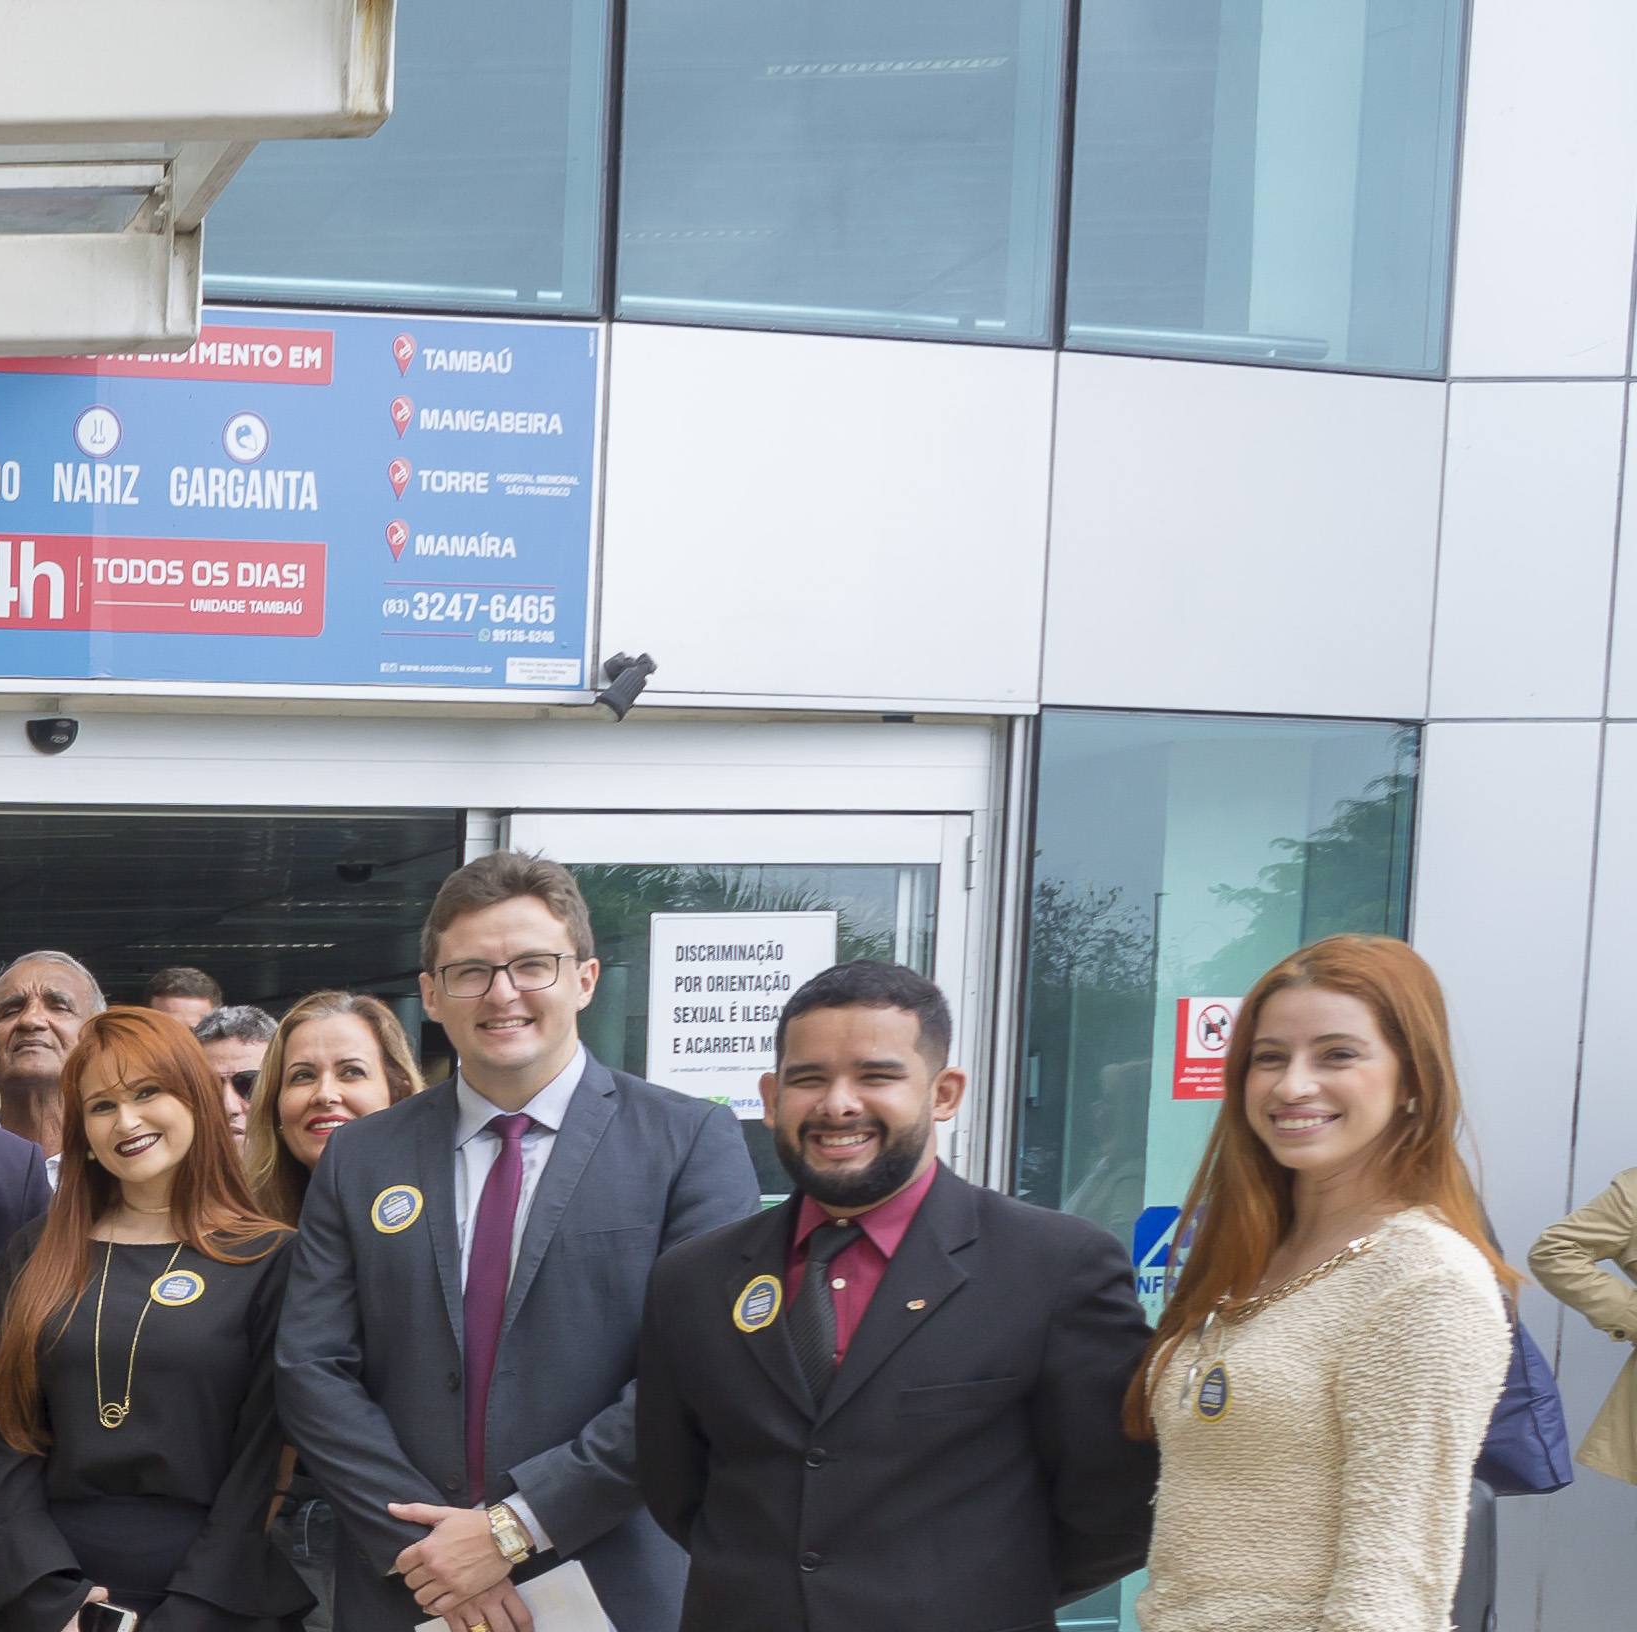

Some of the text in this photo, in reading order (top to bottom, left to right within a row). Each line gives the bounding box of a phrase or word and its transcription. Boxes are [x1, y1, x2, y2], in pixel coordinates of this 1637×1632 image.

[288, 345, 323, 370] EM
[422, 347, 512, 374] TAMBAÚ
[419, 408, 563, 435] MANGABEIRA
[53, 462, 140, 505] NARIZ
[170, 466, 319, 511] GARGANTA
[418, 470, 490, 494] TORRE
[415, 531, 517, 558] MANAÍRA
[93, 557, 305, 588] TODOS OS DIAS!
[190, 598, 302, 614] UNIDADE TAMBAÚ
[382, 591, 555, 624] (83) 3247-6465
[675, 940, 784, 965] DISCRIMINAÇÃO
[674, 971, 790, 996] POR ORIENTAÇÃO
[673, 1006, 725, 1023] SEXUAL
[729, 1001, 738, 1022] É
[673, 1037, 681, 1054] E
[685, 1036, 756, 1054] ACARRETA
